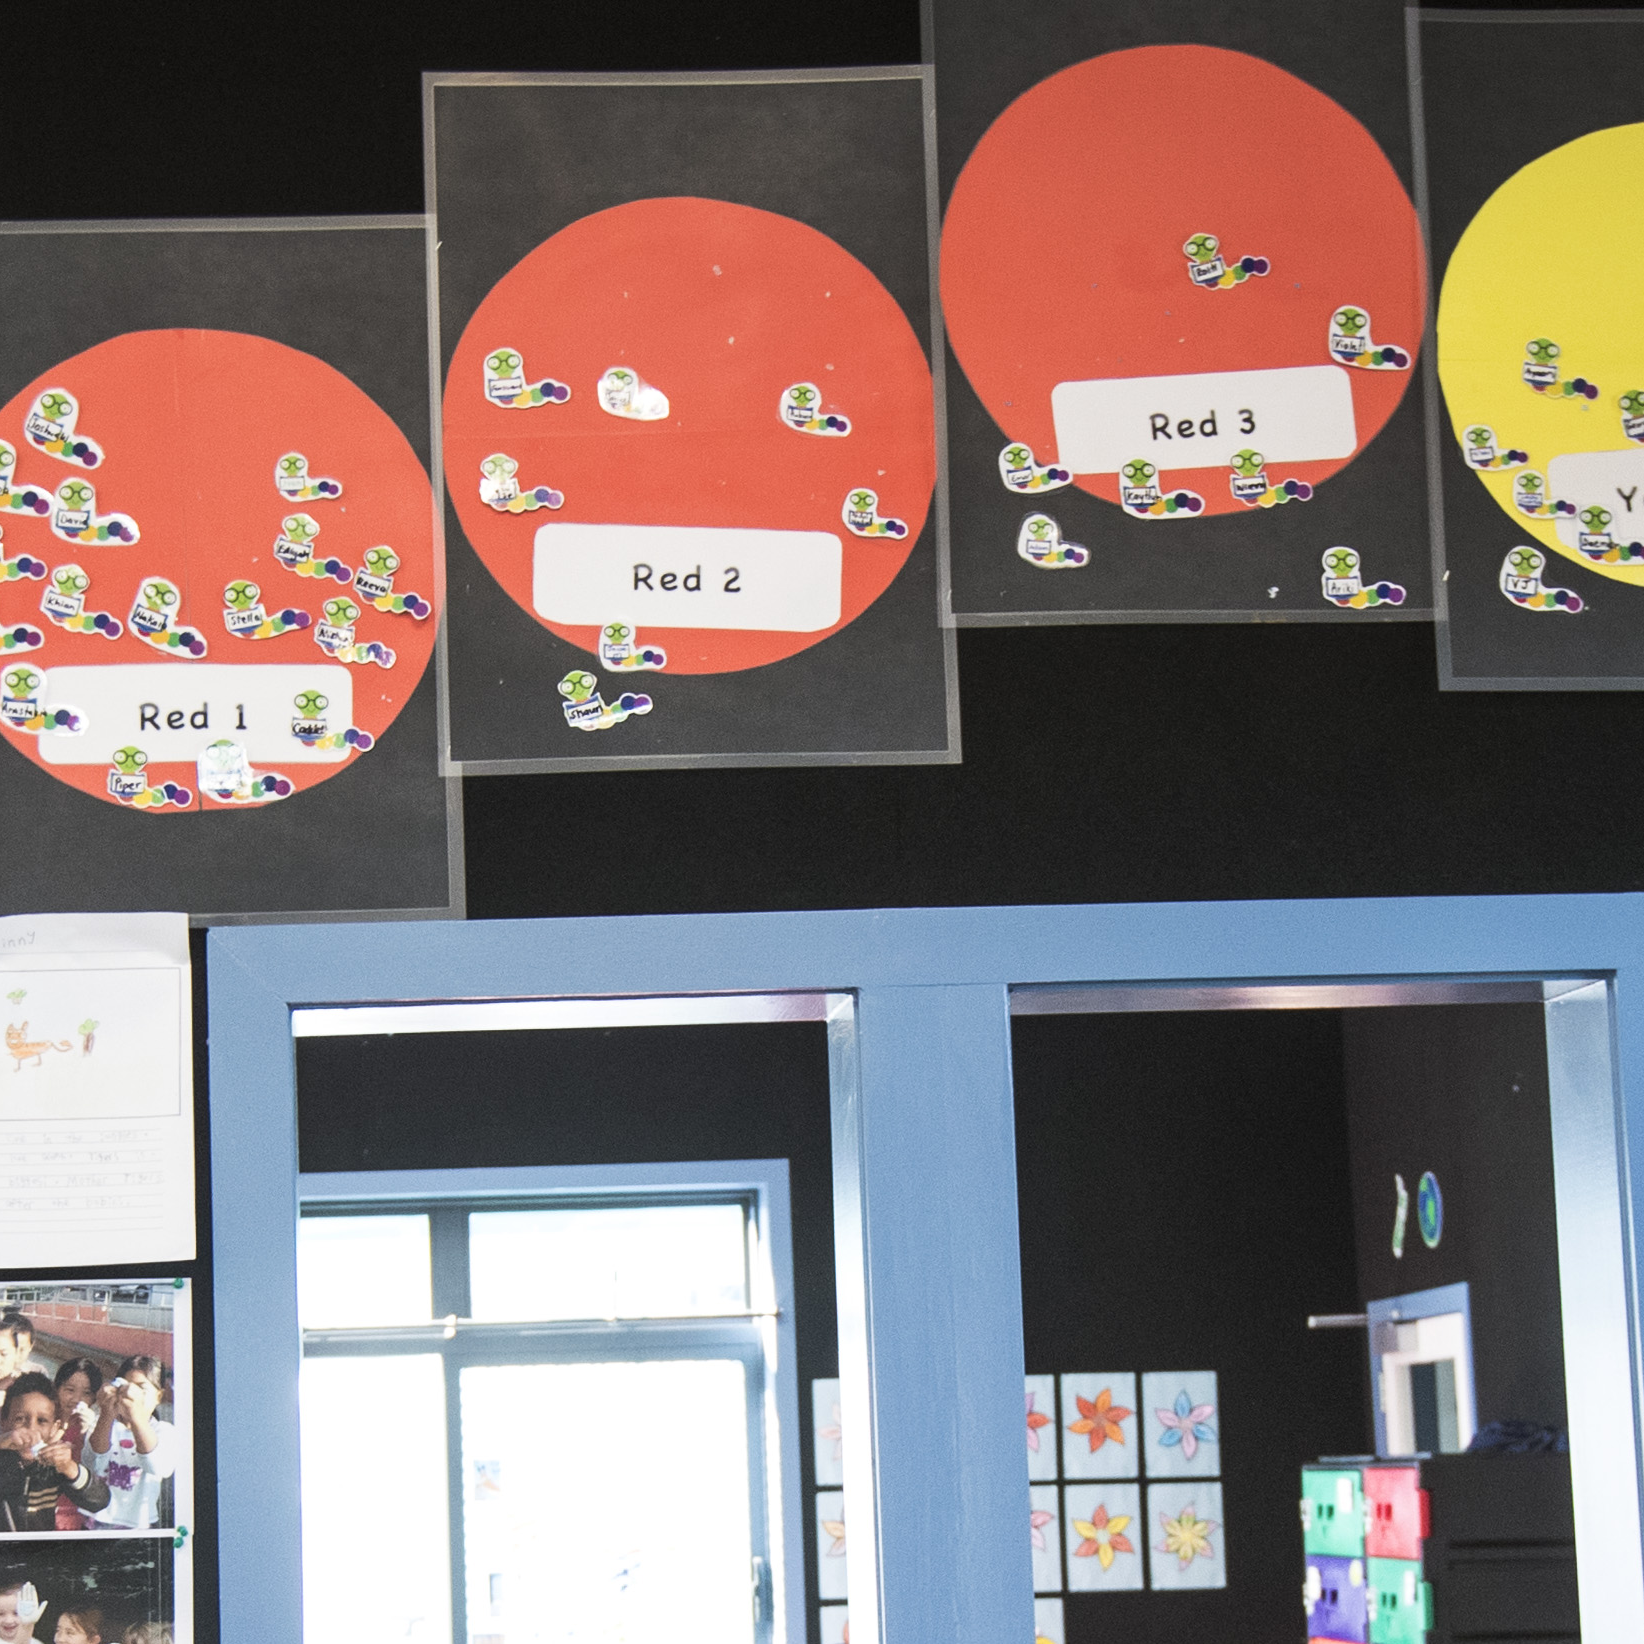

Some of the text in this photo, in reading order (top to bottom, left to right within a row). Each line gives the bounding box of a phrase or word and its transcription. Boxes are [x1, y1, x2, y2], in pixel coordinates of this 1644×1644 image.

[1150, 409, 1255, 440] Red 3
[634, 564, 740, 592] Red 2
[230, 612, 261, 625] Stella
[140, 703, 246, 730] Red 1
[115, 776, 143, 791] Piper
